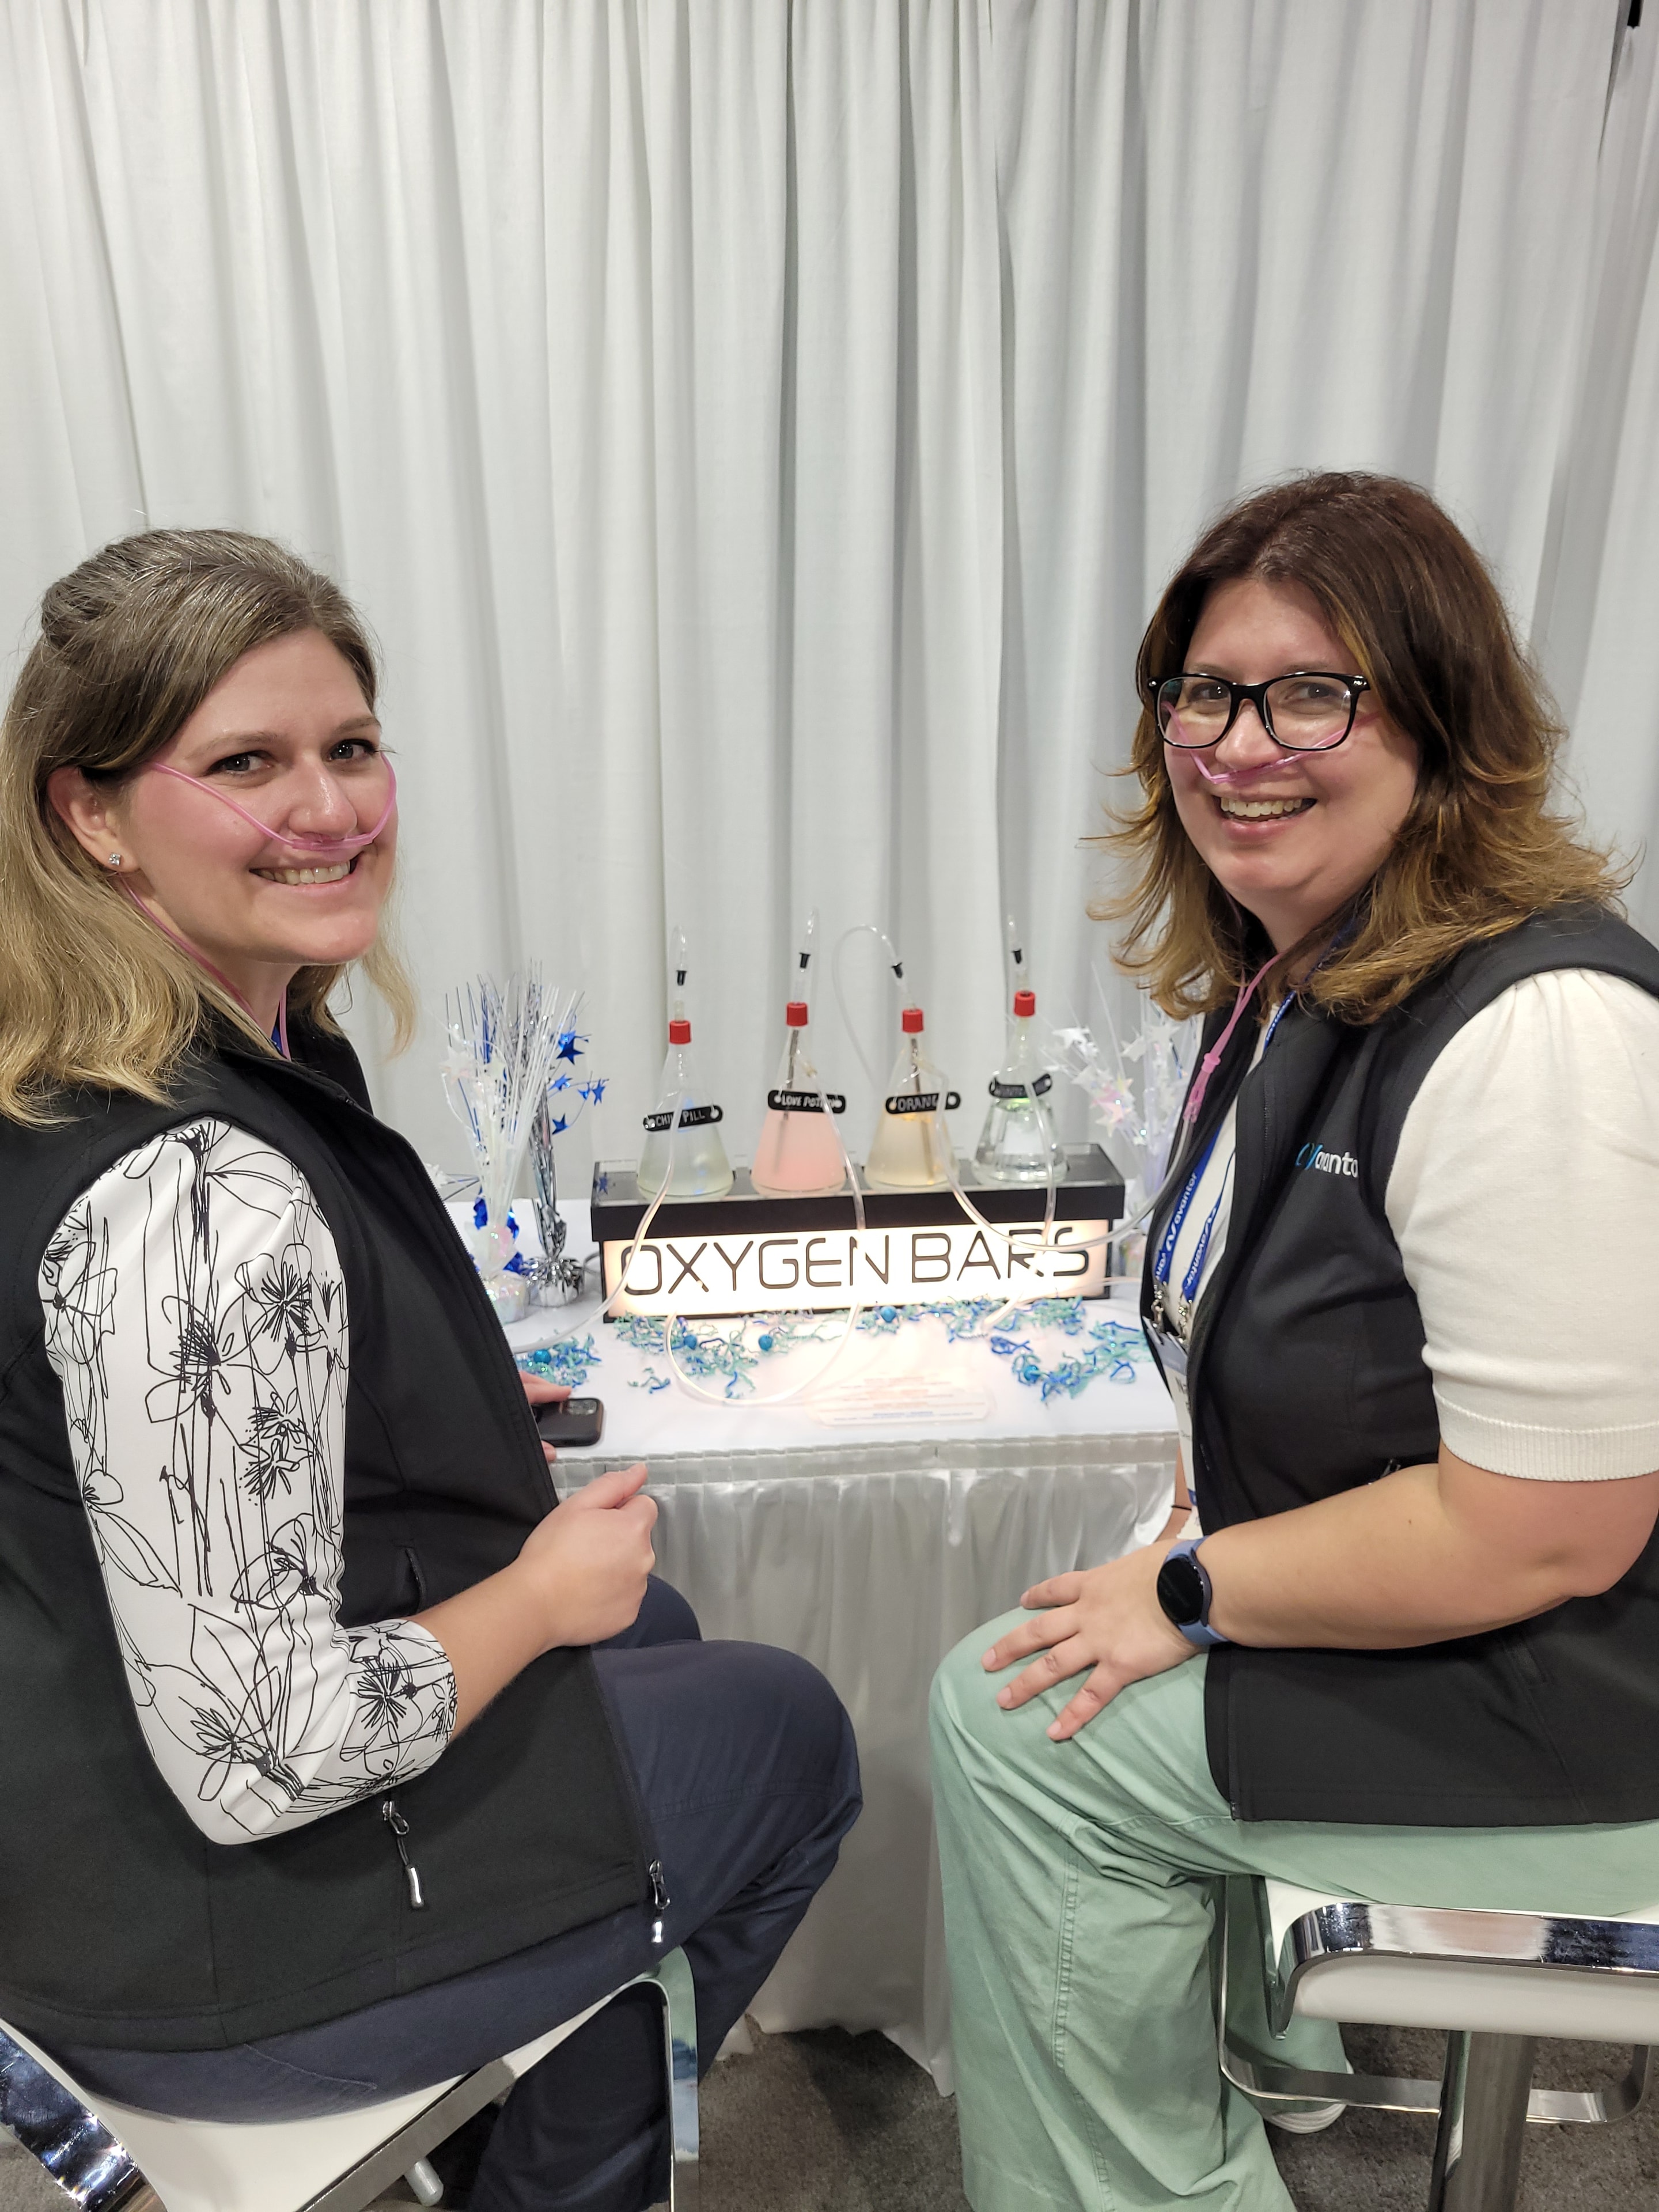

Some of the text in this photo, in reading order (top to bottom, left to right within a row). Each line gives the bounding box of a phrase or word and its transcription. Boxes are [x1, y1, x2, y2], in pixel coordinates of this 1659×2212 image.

[782, 1093, 802, 1106] LOVE
[682, 1110, 706, 1123] PILL
[1174, 1172, 1198, 1225] avantor
[620, 1234, 889, 1296] OXYGEN
[912, 1226, 1089, 1283] BARS
